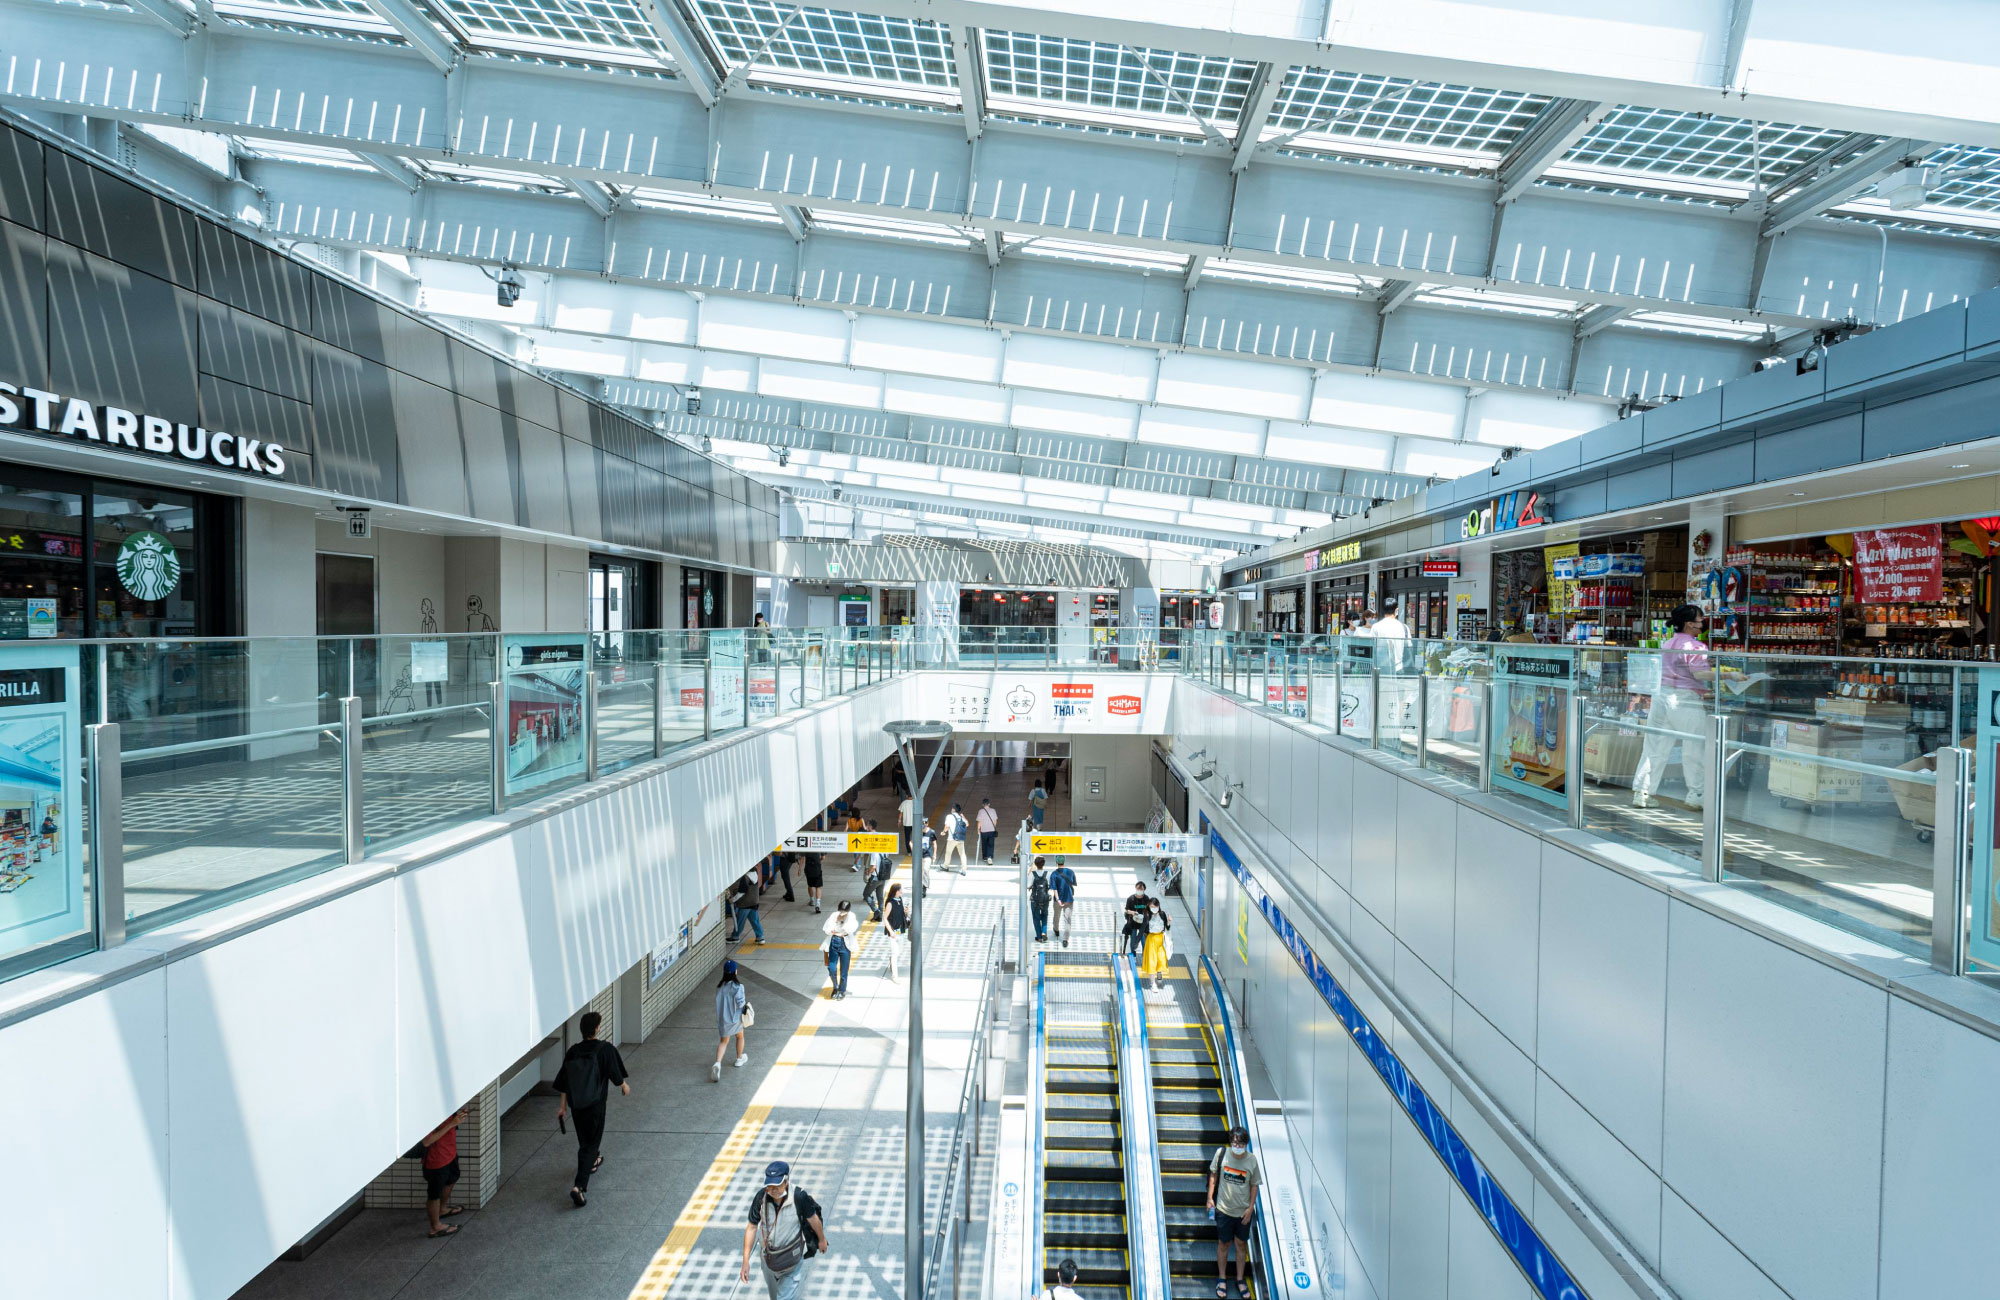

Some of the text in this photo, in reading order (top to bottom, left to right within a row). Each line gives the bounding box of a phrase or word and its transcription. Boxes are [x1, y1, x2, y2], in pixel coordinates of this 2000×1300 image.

[0, 381, 286, 476] STARBUCKS
[1915, 545, 1937, 558] sale
[1545, 663, 1560, 674] KIKU
[0, 681, 41, 697] RILLA
[1109, 698, 1140, 709] SCHMATZ
[1053, 704, 1075, 717] THAI
